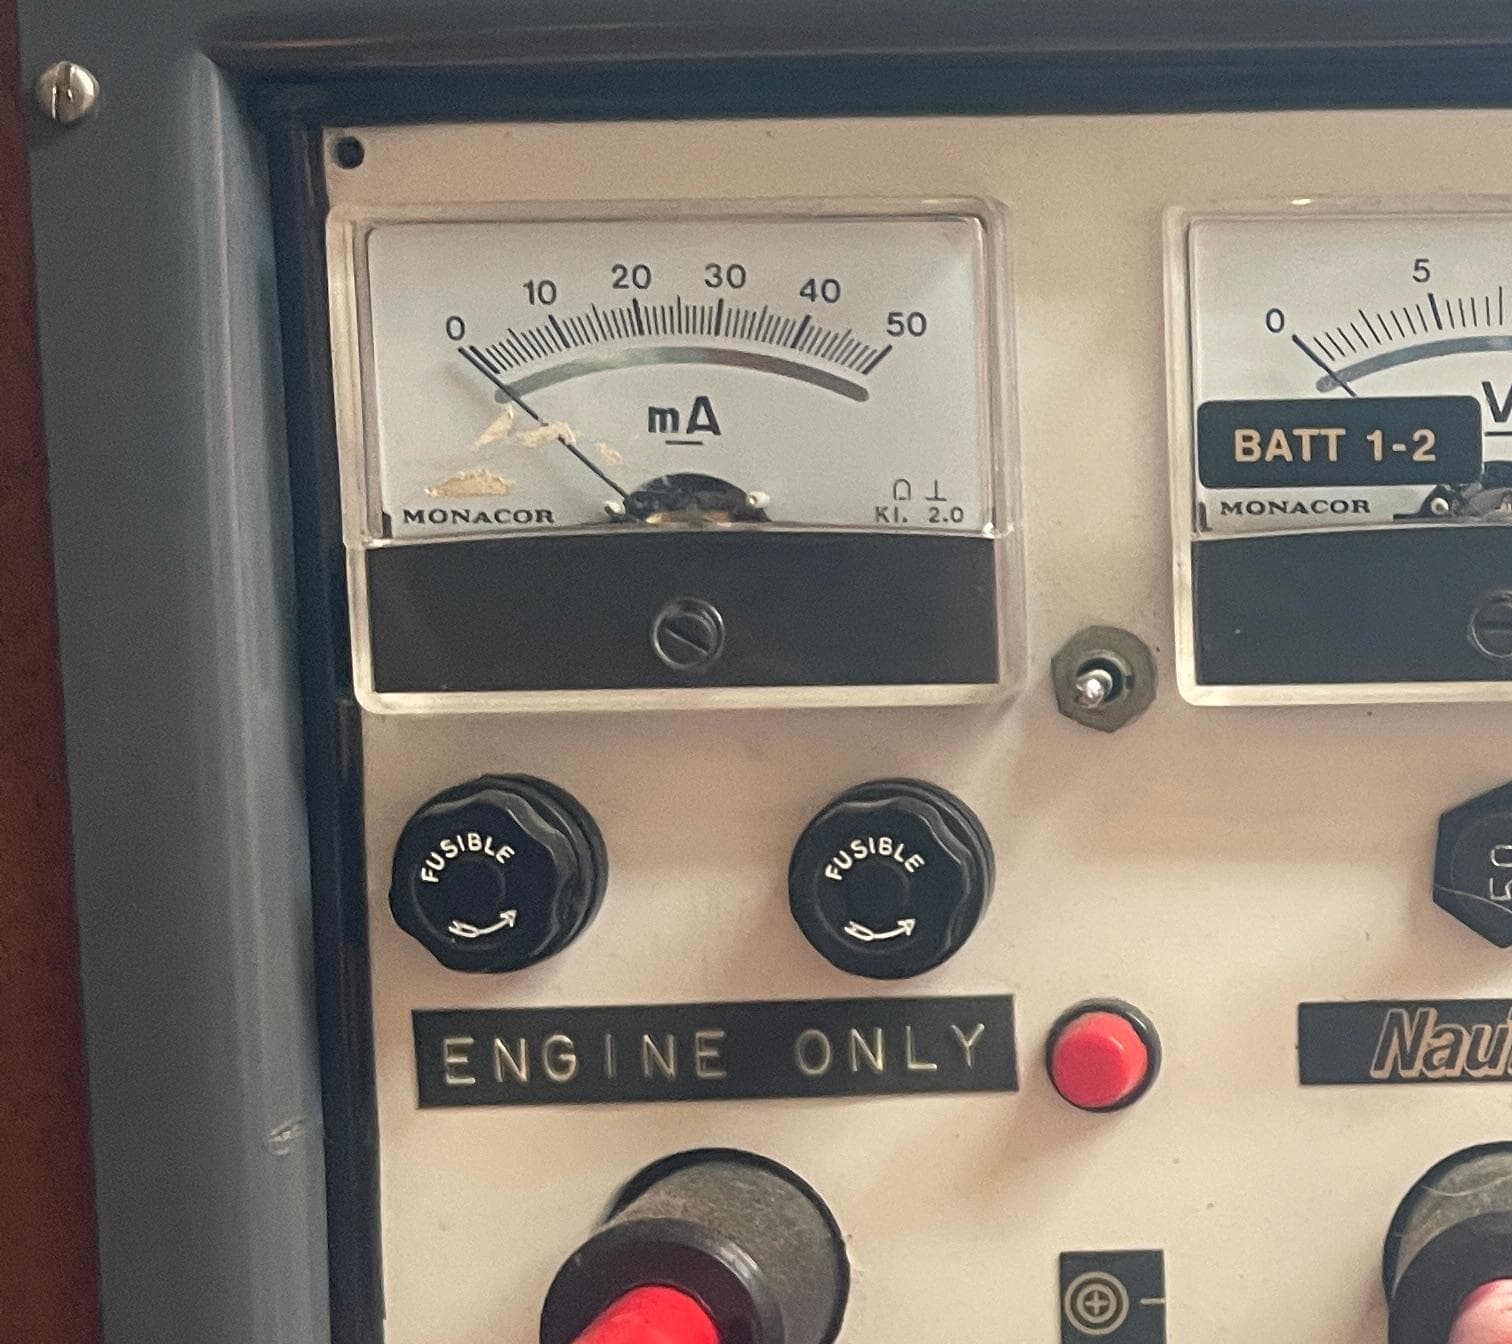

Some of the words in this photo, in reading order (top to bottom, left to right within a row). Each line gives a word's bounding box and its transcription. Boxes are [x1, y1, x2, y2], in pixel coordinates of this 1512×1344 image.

[444, 314, 467, 342] 0
[522, 279, 558, 307] 10
[610, 263, 653, 292] 20
[703, 262, 747, 291] 30
[798, 276, 842, 305] 40
[885, 310, 928, 339] 50
[1264, 307, 1287, 335] 0
[1411, 257, 1432, 284] 5
[646, 394, 723, 437] mA
[1233, 426, 1347, 463] BATT
[1365, 428, 1437, 463] 1-2
[401, 507, 556, 526] MONACOR
[927, 505, 965, 525] 2.0
[1219, 498, 1371, 517] MONACOR
[419, 831, 516, 885] FUSIBLE
[824, 835, 926, 884] FUSIBLE
[442, 1029, 729, 1086] ENGINE
[795, 1022, 986, 1076] ONLY
